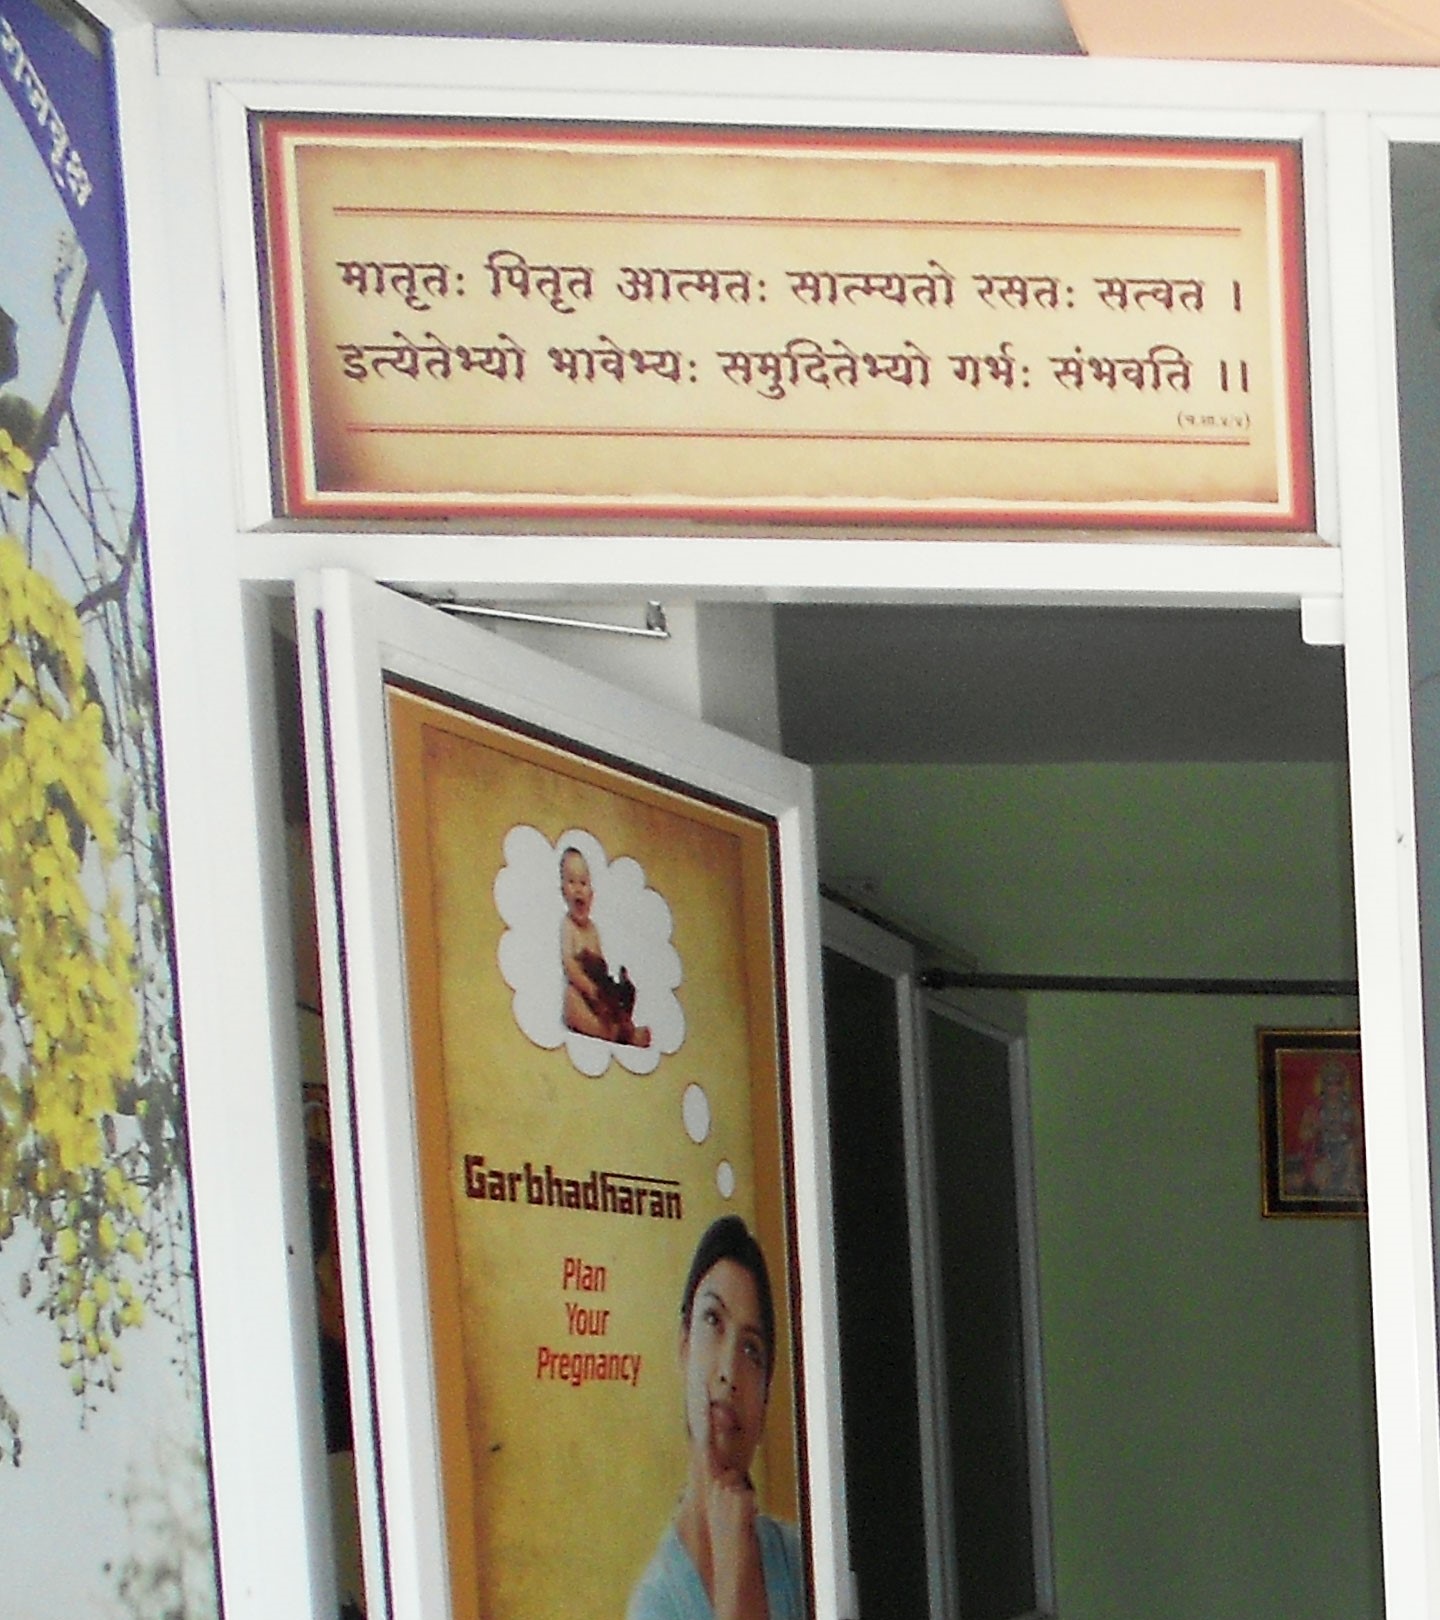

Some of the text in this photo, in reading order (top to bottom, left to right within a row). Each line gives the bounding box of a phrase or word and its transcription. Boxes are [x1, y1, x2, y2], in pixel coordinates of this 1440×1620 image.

[484, 250, 593, 313] पितृत
[1094, 277, 1205, 311] सत्वत
[336, 331, 526, 383] इत्येतेभ्यो
[717, 338, 931, 400] समुदितेभ्यो
[1049, 344, 1194, 393] संभवति
[464, 1154, 682, 1220] Garbhadharan
[562, 1257, 606, 1292] Plan
[566, 1302, 610, 1336] Your
[536, 1346, 641, 1388] Pregnancy
